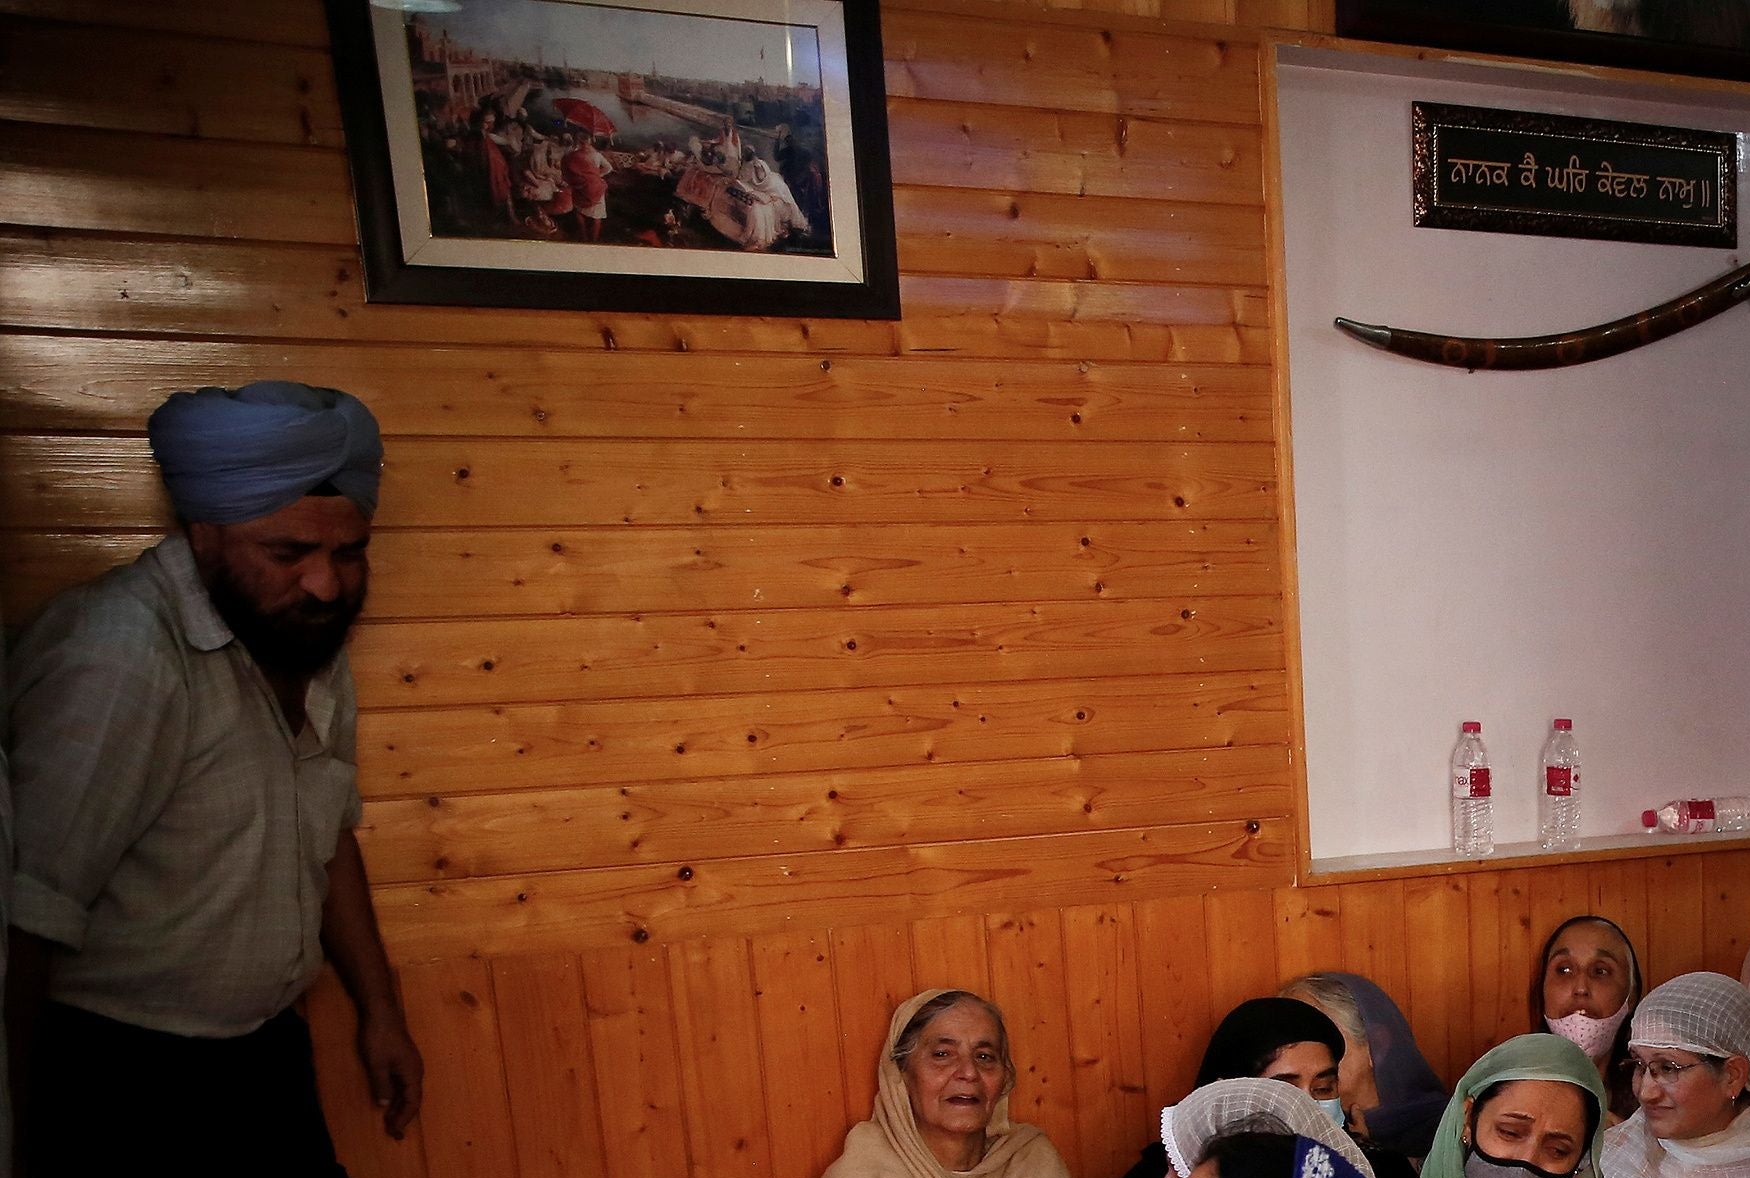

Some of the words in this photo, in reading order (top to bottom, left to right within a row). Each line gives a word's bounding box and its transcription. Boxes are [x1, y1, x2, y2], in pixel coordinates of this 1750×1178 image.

[1447, 158, 1511, 187] ਨਾਨਕ
[1518, 152, 1539, 188] ਕੈ
[1545, 155, 1590, 193] ਘਰਿ
[1595, 161, 1650, 198] ਕੇਵਲ
